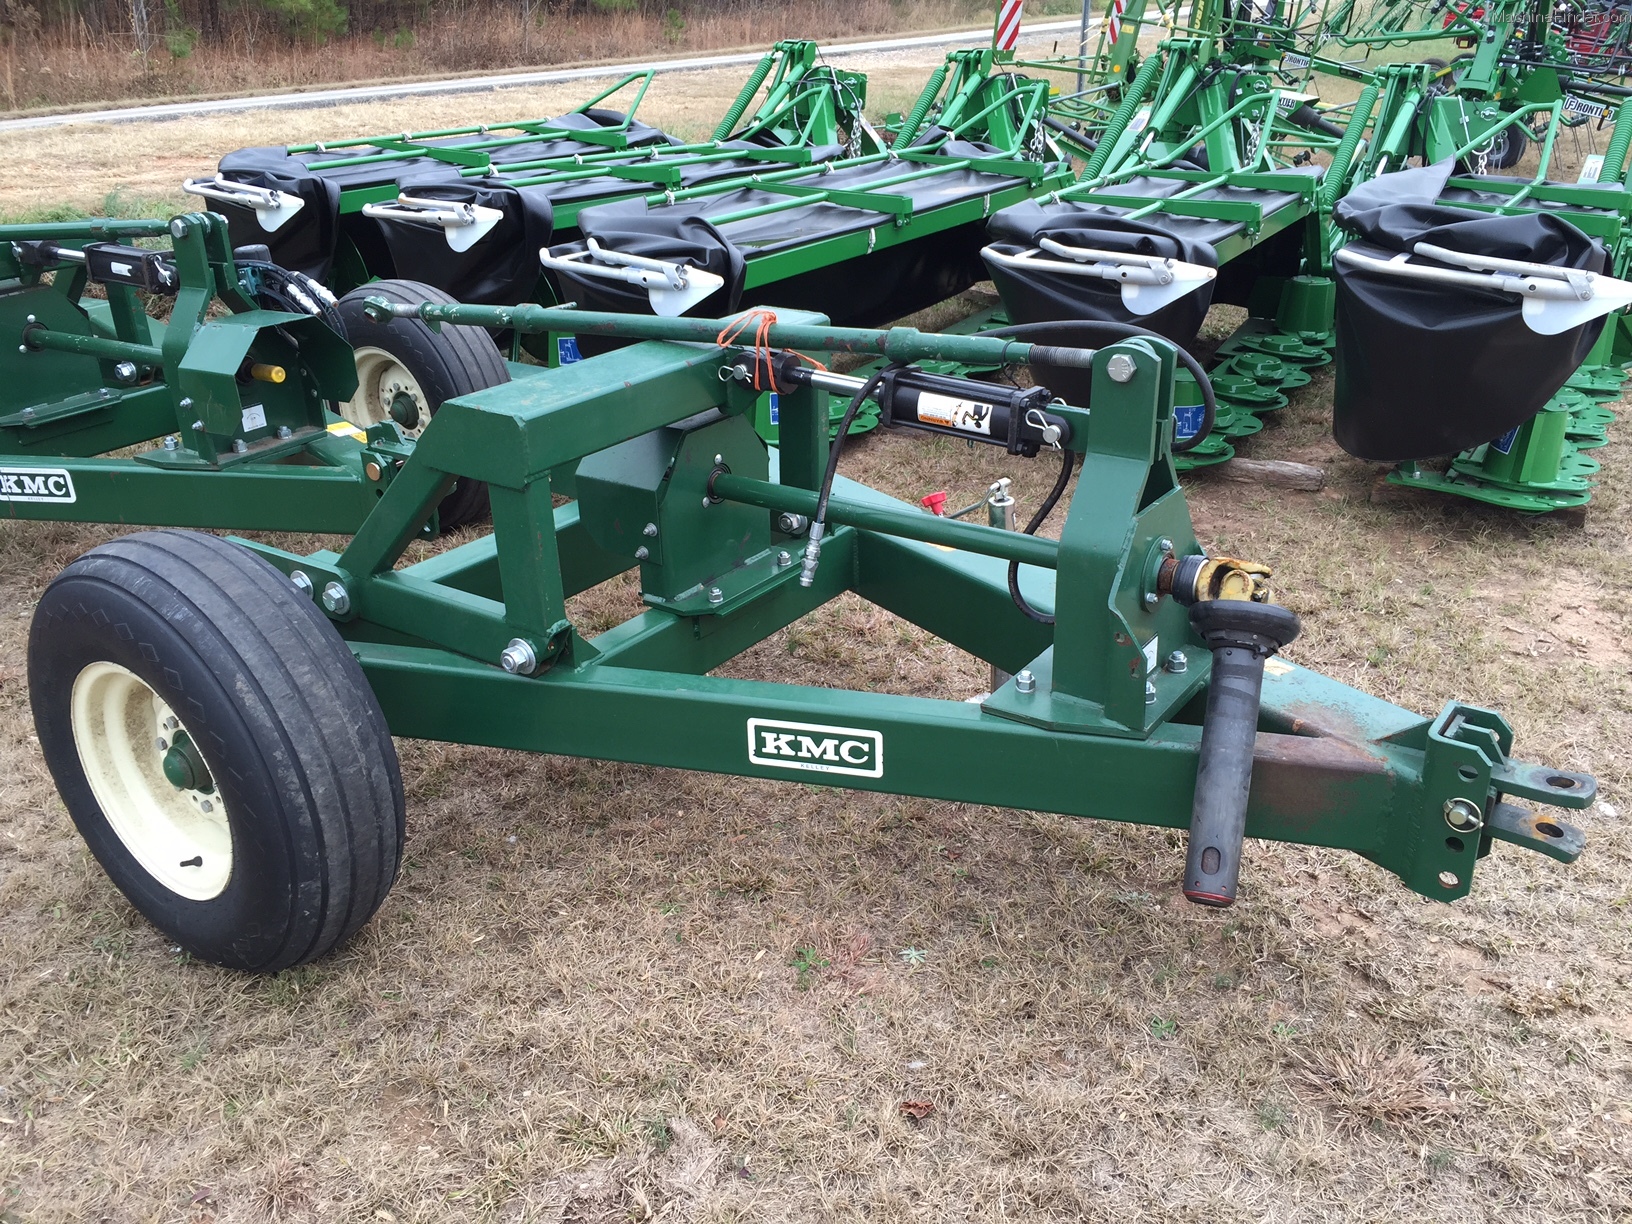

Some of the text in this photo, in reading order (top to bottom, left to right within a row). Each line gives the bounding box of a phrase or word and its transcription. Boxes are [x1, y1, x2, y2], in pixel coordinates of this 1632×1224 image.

[0, 474, 67, 496] KMC
[760, 731, 870, 764] KMC
[800, 763, 830, 771] KELLEY
